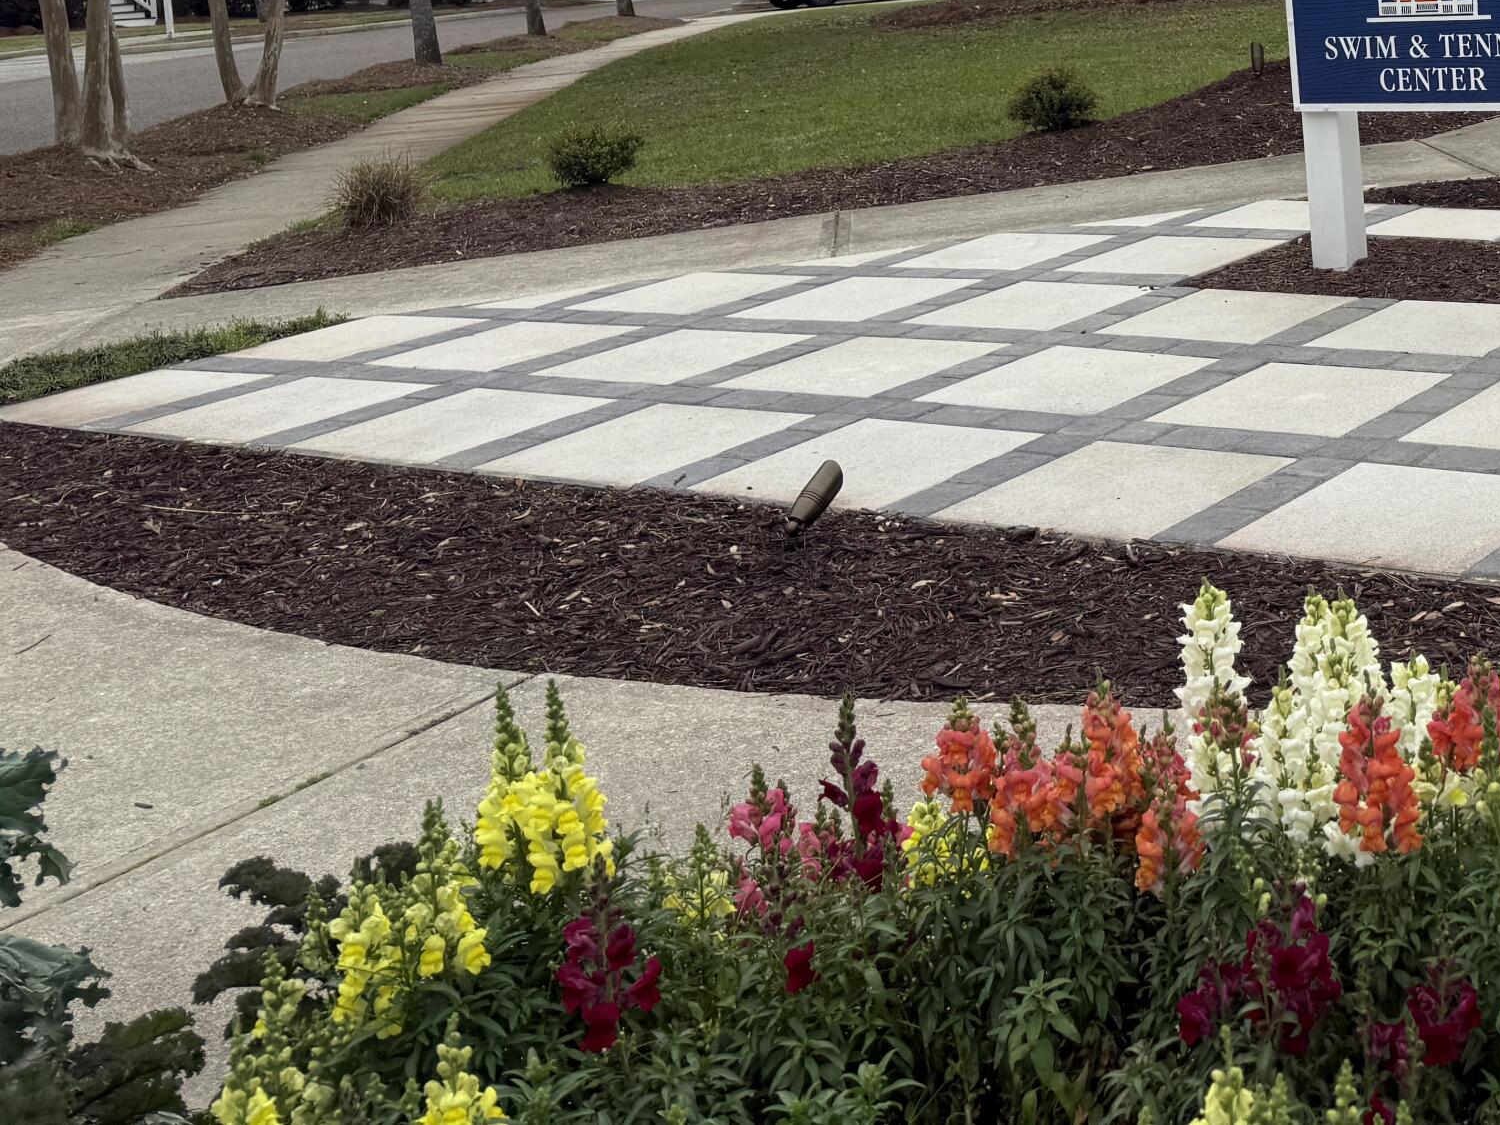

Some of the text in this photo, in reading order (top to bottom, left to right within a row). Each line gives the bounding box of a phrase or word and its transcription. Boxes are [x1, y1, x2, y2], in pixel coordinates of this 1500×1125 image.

[1324, 35, 1399, 60] SWIM
[1409, 34, 1430, 59] &
[1379, 66, 1488, 92] CENTER
